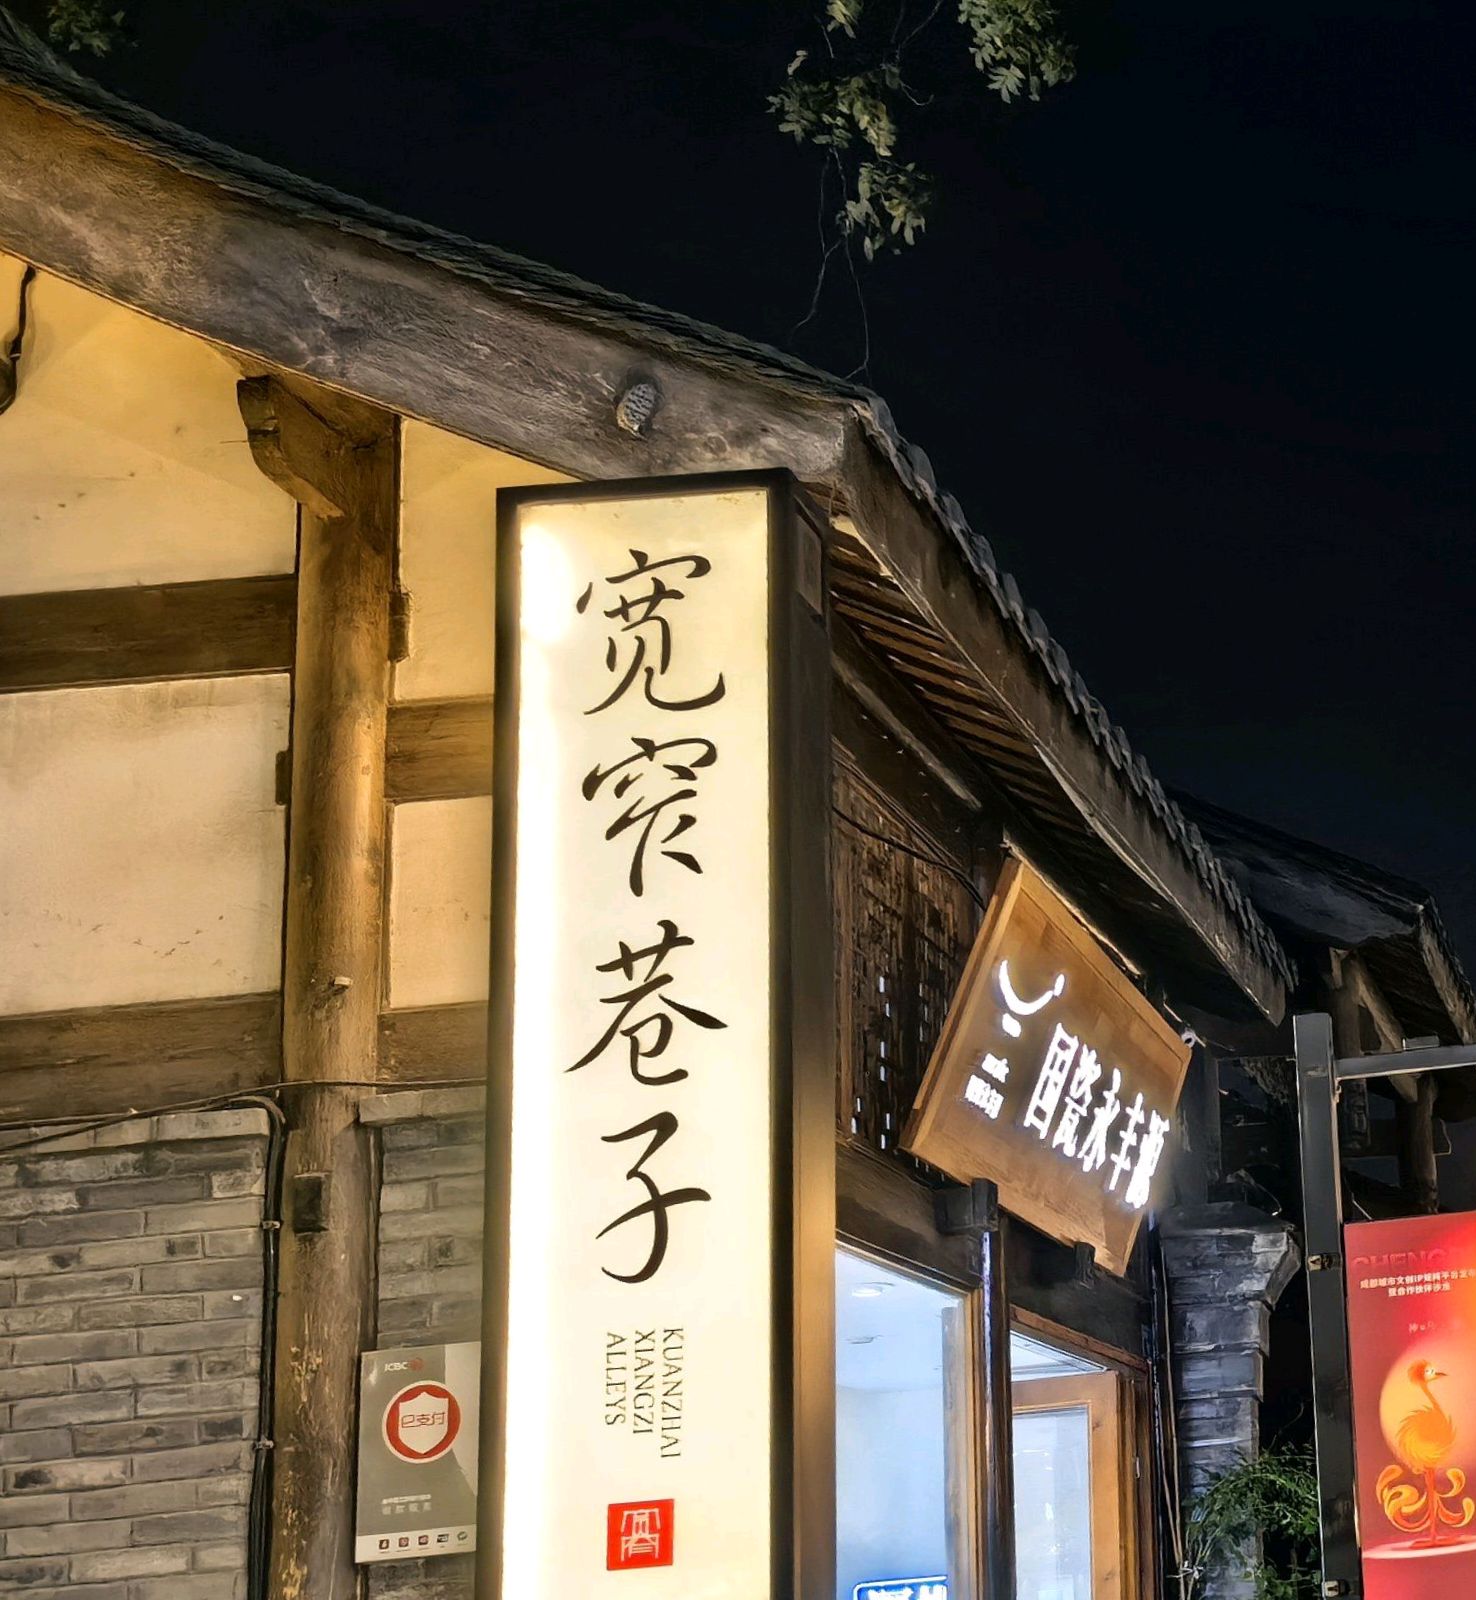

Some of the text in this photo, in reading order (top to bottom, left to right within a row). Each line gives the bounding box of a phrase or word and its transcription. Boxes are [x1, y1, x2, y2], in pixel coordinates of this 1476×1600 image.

[566, 548, 728, 1285] 宽窄巷子
[384, 1361, 408, 1372] ICBC
[604, 1332, 628, 1426] ALLEYS
[632, 1330, 656, 1434] XIANGZI
[660, 1328, 684, 1458] KUANZHAI
